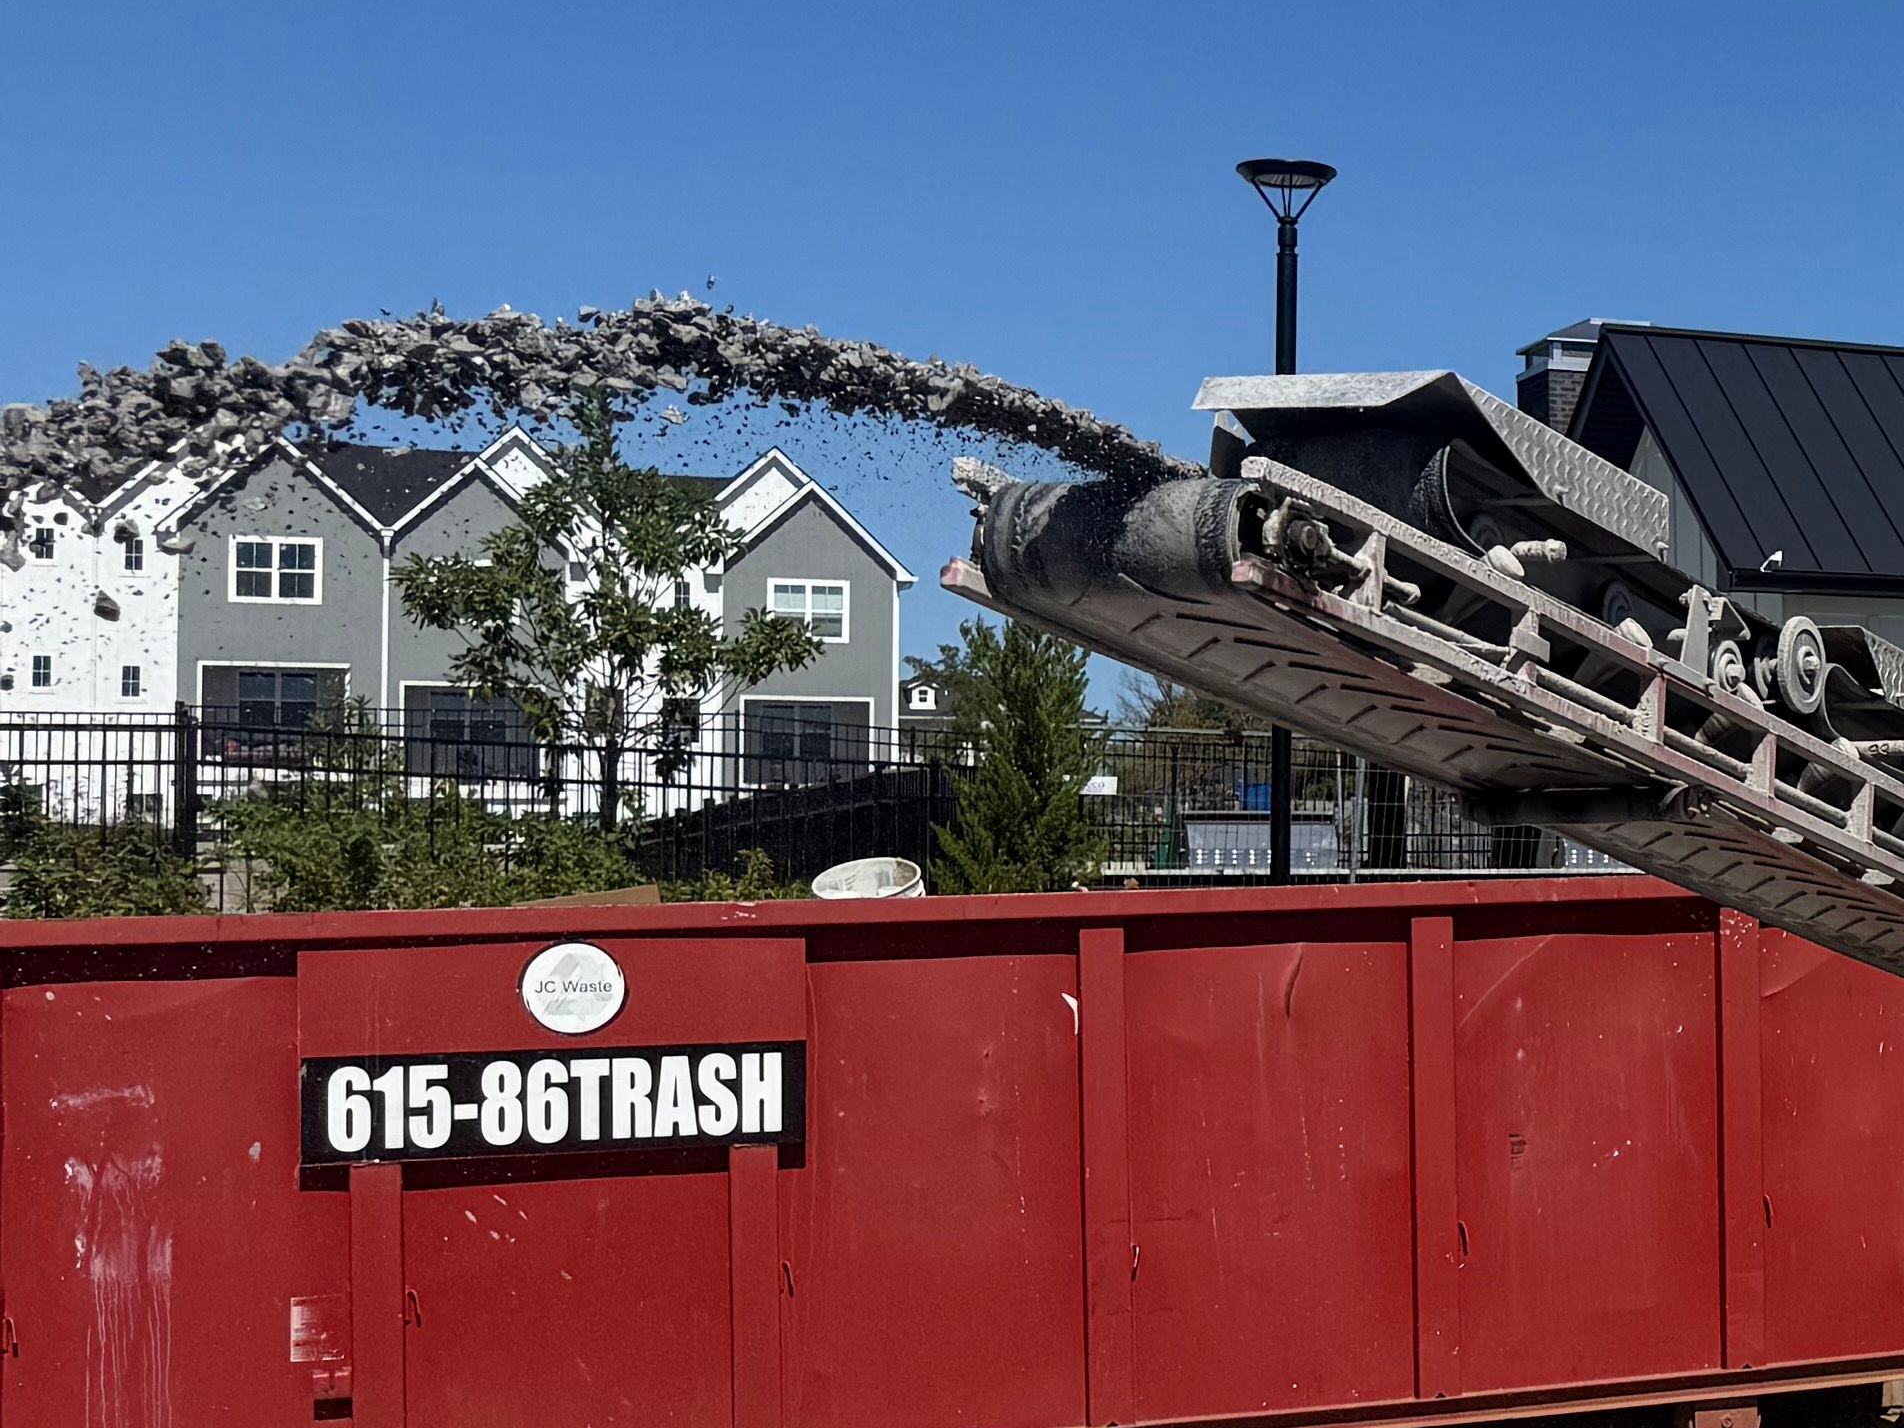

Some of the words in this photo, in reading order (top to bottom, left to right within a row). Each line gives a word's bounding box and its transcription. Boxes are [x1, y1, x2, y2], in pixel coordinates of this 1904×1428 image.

[535, 980, 556, 994] JC
[563, 980, 613, 993] Waste
[327, 1051, 783, 1153] 615-86TRASH
